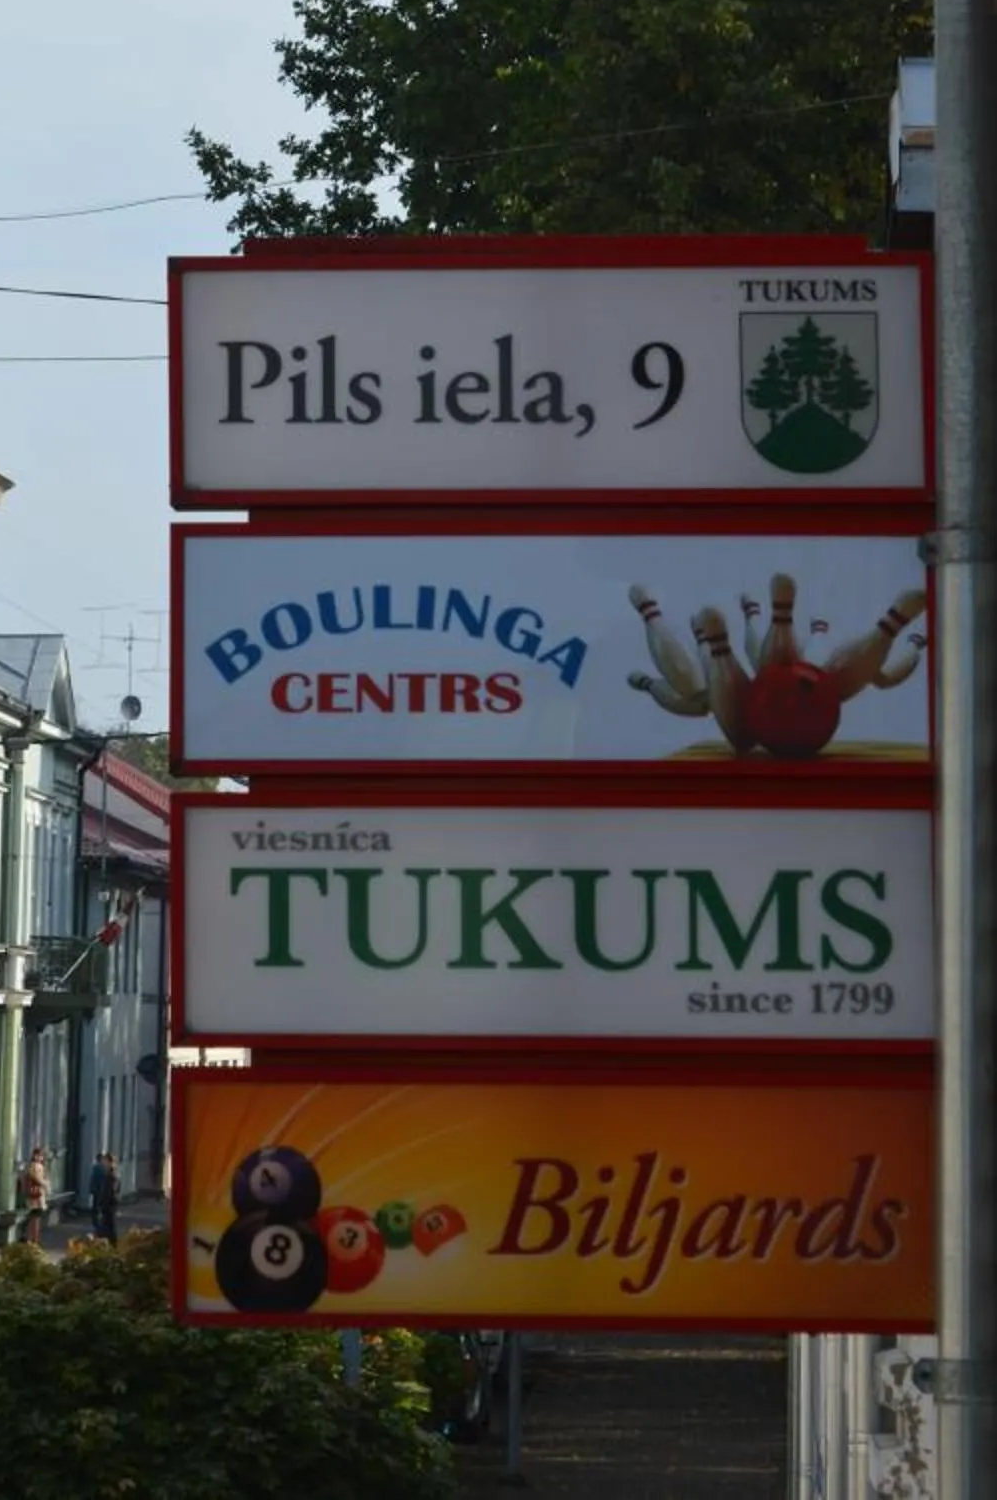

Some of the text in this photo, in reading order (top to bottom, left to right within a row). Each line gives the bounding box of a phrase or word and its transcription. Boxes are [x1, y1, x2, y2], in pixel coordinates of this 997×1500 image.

[739, 279, 877, 303] TUKUMS
[217, 333, 686, 438] Pils iela, 9
[204, 584, 588, 689] BOULINGA
[270, 672, 523, 714] CENTRS
[229, 866, 895, 974] TUKUMS
[687, 980, 895, 1015] since 1799
[486, 1151, 907, 1296] Biljards
[192, 1235, 217, 1255] 1
[262, 1232, 292, 1266] 8
